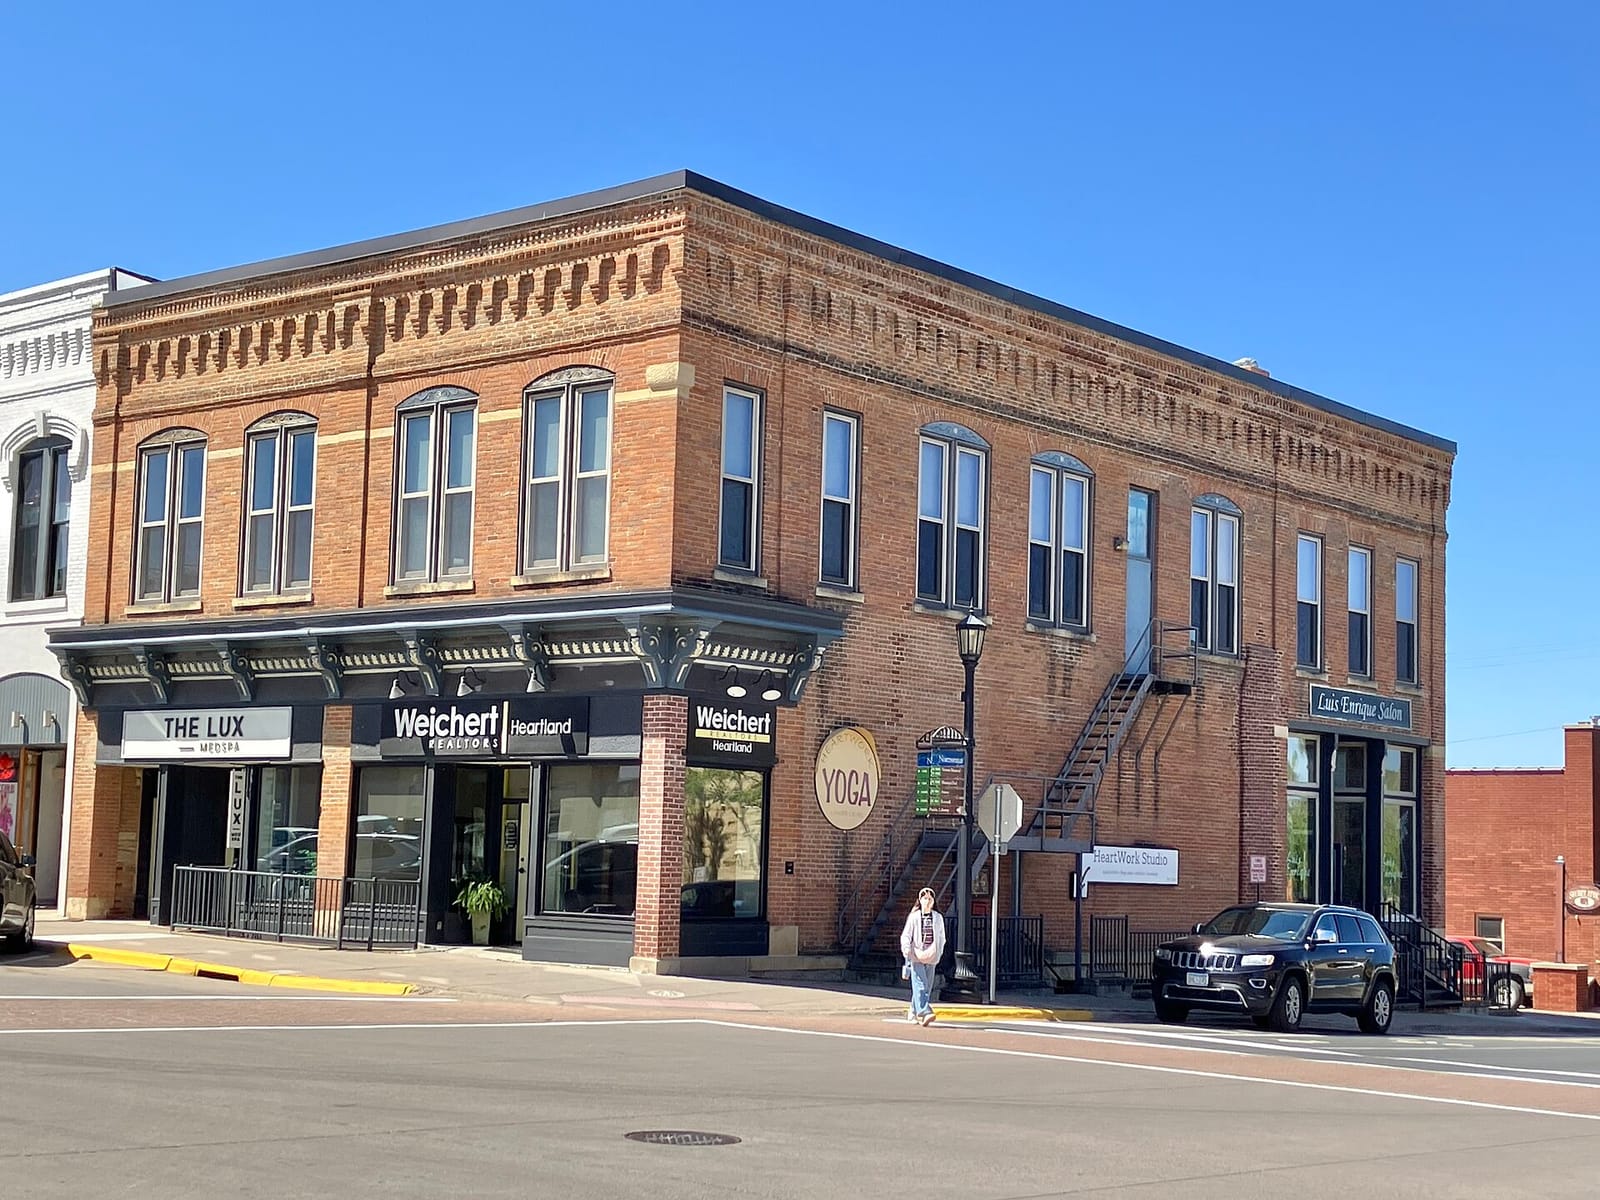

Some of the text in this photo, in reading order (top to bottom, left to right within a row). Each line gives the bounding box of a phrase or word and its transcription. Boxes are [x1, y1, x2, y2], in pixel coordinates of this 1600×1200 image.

[1317, 693, 1403, 721] Luis Enrique Salon
[164, 715, 245, 739] THE LUX
[394, 705, 499, 738] Weichert
[510, 718, 572, 736] Heartland
[696, 705, 771, 734] Weichert
[200, 741, 241, 754] MEDSPA
[428, 738, 499, 750] REALTORS
[712, 739, 753, 754] Heartland
[822, 767, 872, 807] YOGA
[232, 782, 242, 825] LUX
[1093, 849, 1168, 866] HeartWork Studio
